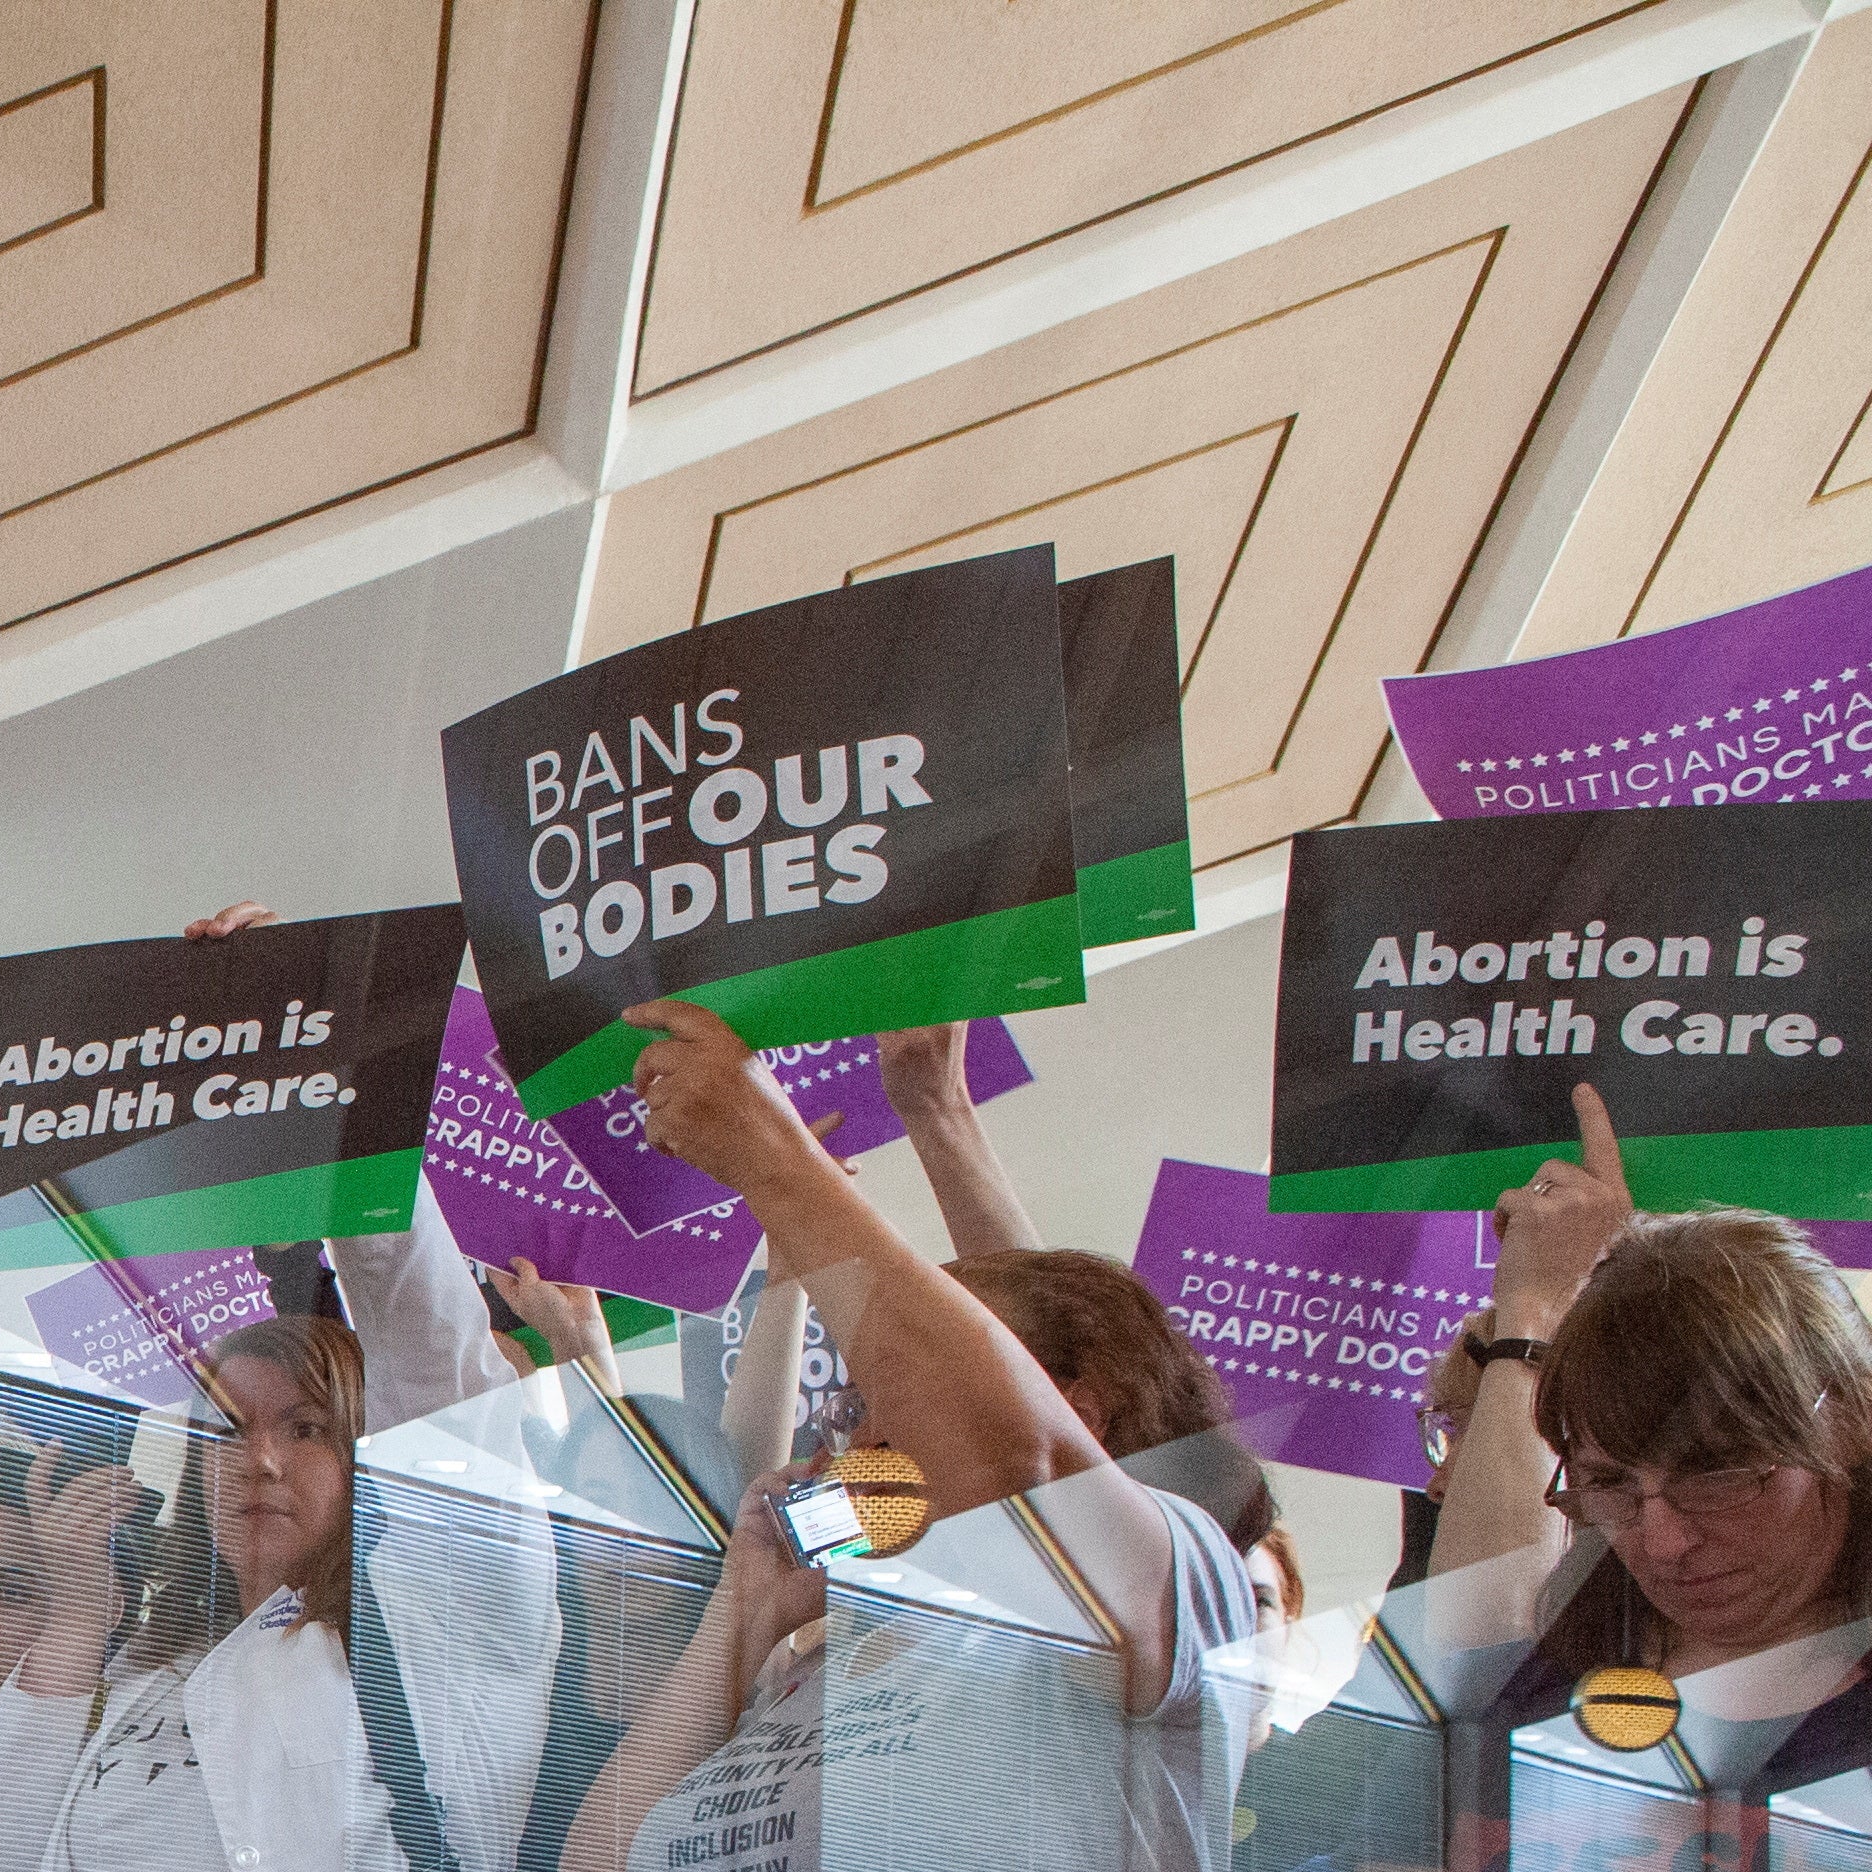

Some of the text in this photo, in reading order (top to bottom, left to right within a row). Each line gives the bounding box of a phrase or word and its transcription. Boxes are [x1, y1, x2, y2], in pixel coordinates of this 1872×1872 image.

[525, 686, 744, 827] BANS
[1475, 726, 1780, 810] POLITICIANS
[528, 734, 933, 902] OFF OUR
[537, 823, 888, 982] BODIES
[1354, 917, 1809, 989] Abortion is
[279, 1001, 335, 1048] is
[1352, 1001, 1844, 1064] Health Care.
[193, 1069, 358, 1122] Care.
[84, 1280, 229, 1356] POLITICIANS
[1165, 1304, 1330, 1362] CRAPPY
[1179, 1273, 1421, 1340] POLITICIANS
[84, 1323, 184, 1376] CRAPPY
[693, 1781, 789, 1822] CHOICE
[667, 1811, 797, 1870] INCLUSION
